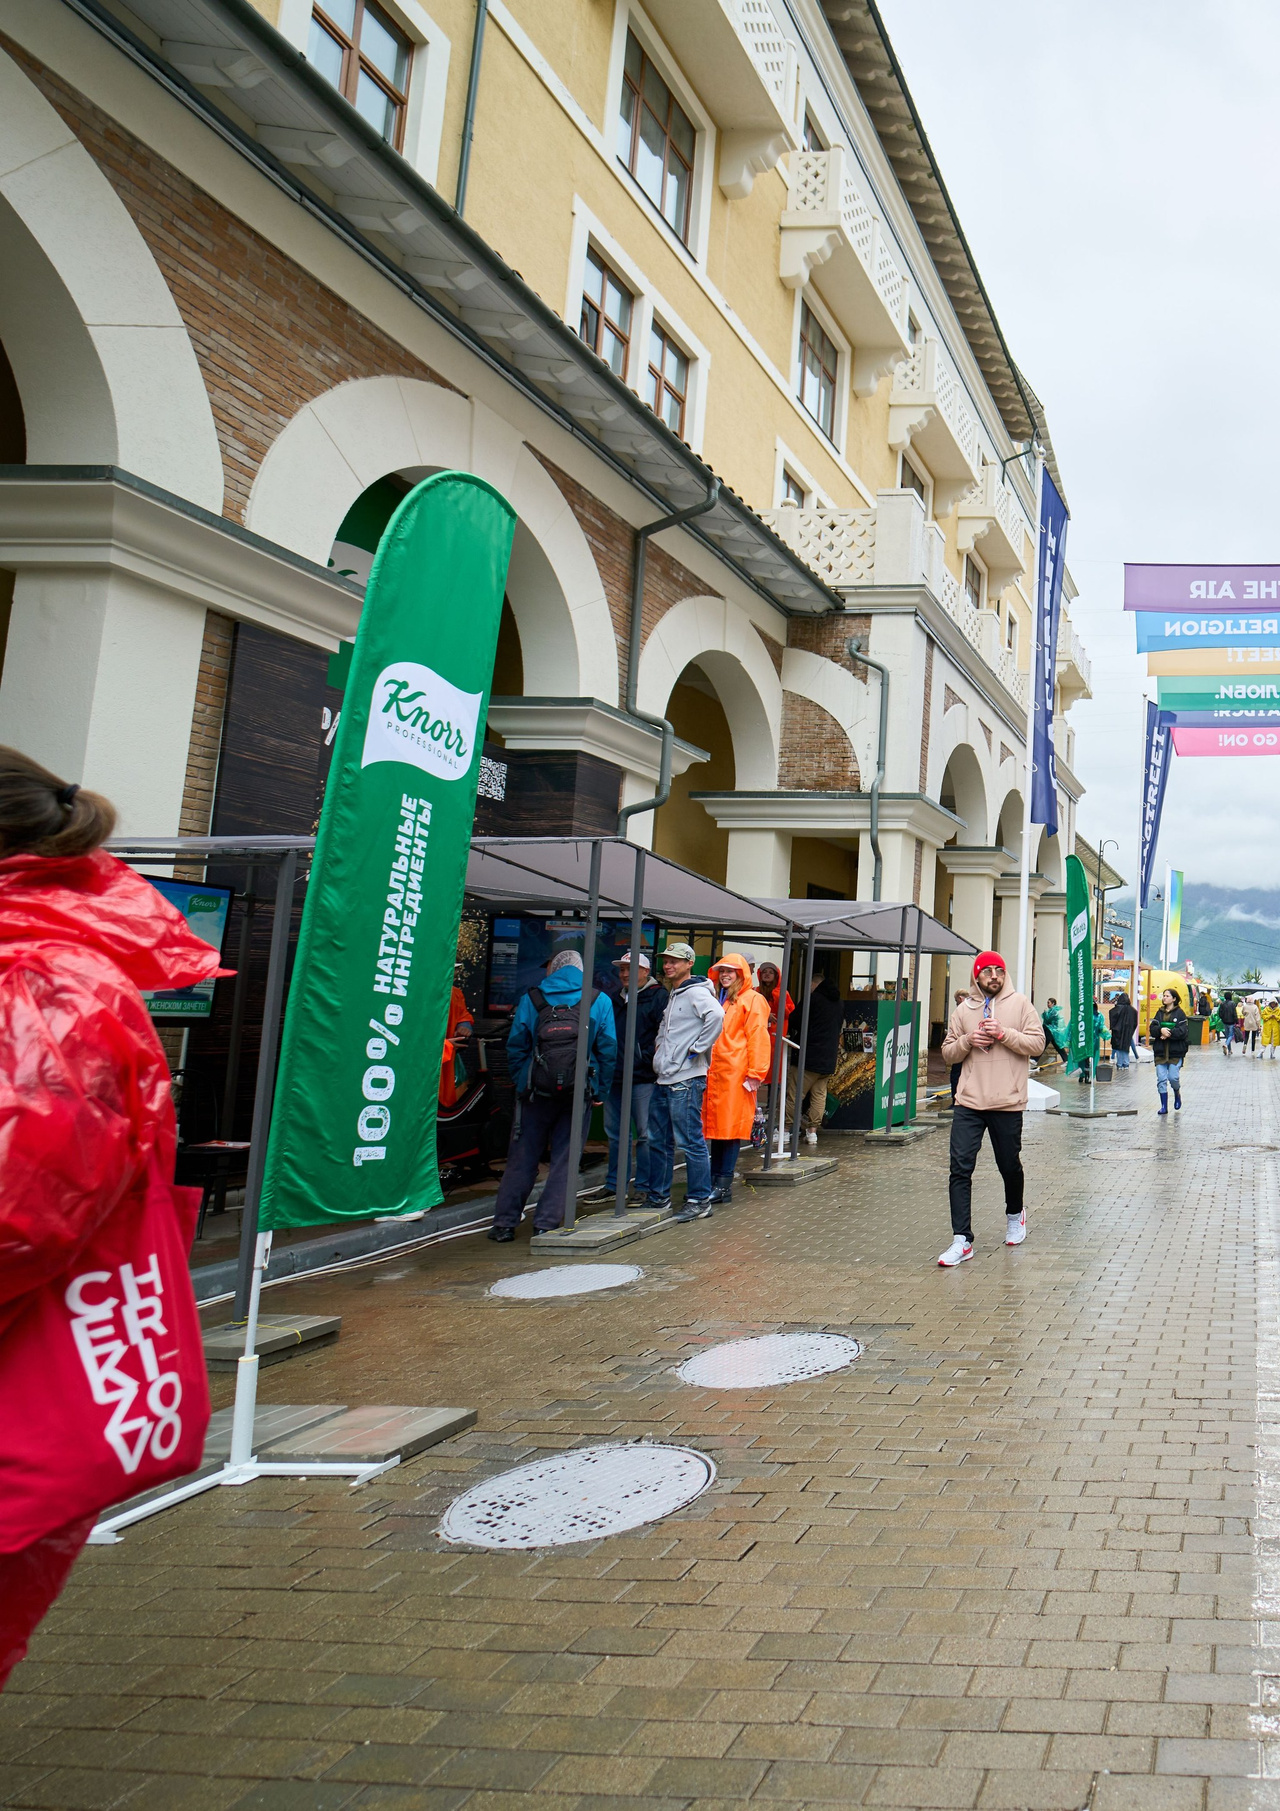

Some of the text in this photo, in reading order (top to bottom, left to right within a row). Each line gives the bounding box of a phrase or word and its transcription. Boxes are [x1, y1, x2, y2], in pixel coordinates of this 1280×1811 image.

[382, 679, 468, 758] Knorr
[387, 721, 458, 770] PROFESSIONAL
[191, 897, 217, 908] Knorr
[373, 793, 418, 994] НАТУРАЛЬНЫЕ
[391, 798, 433, 997] ИНГРЕДИЕНТЫ
[352, 1003, 404, 1167] 100%
